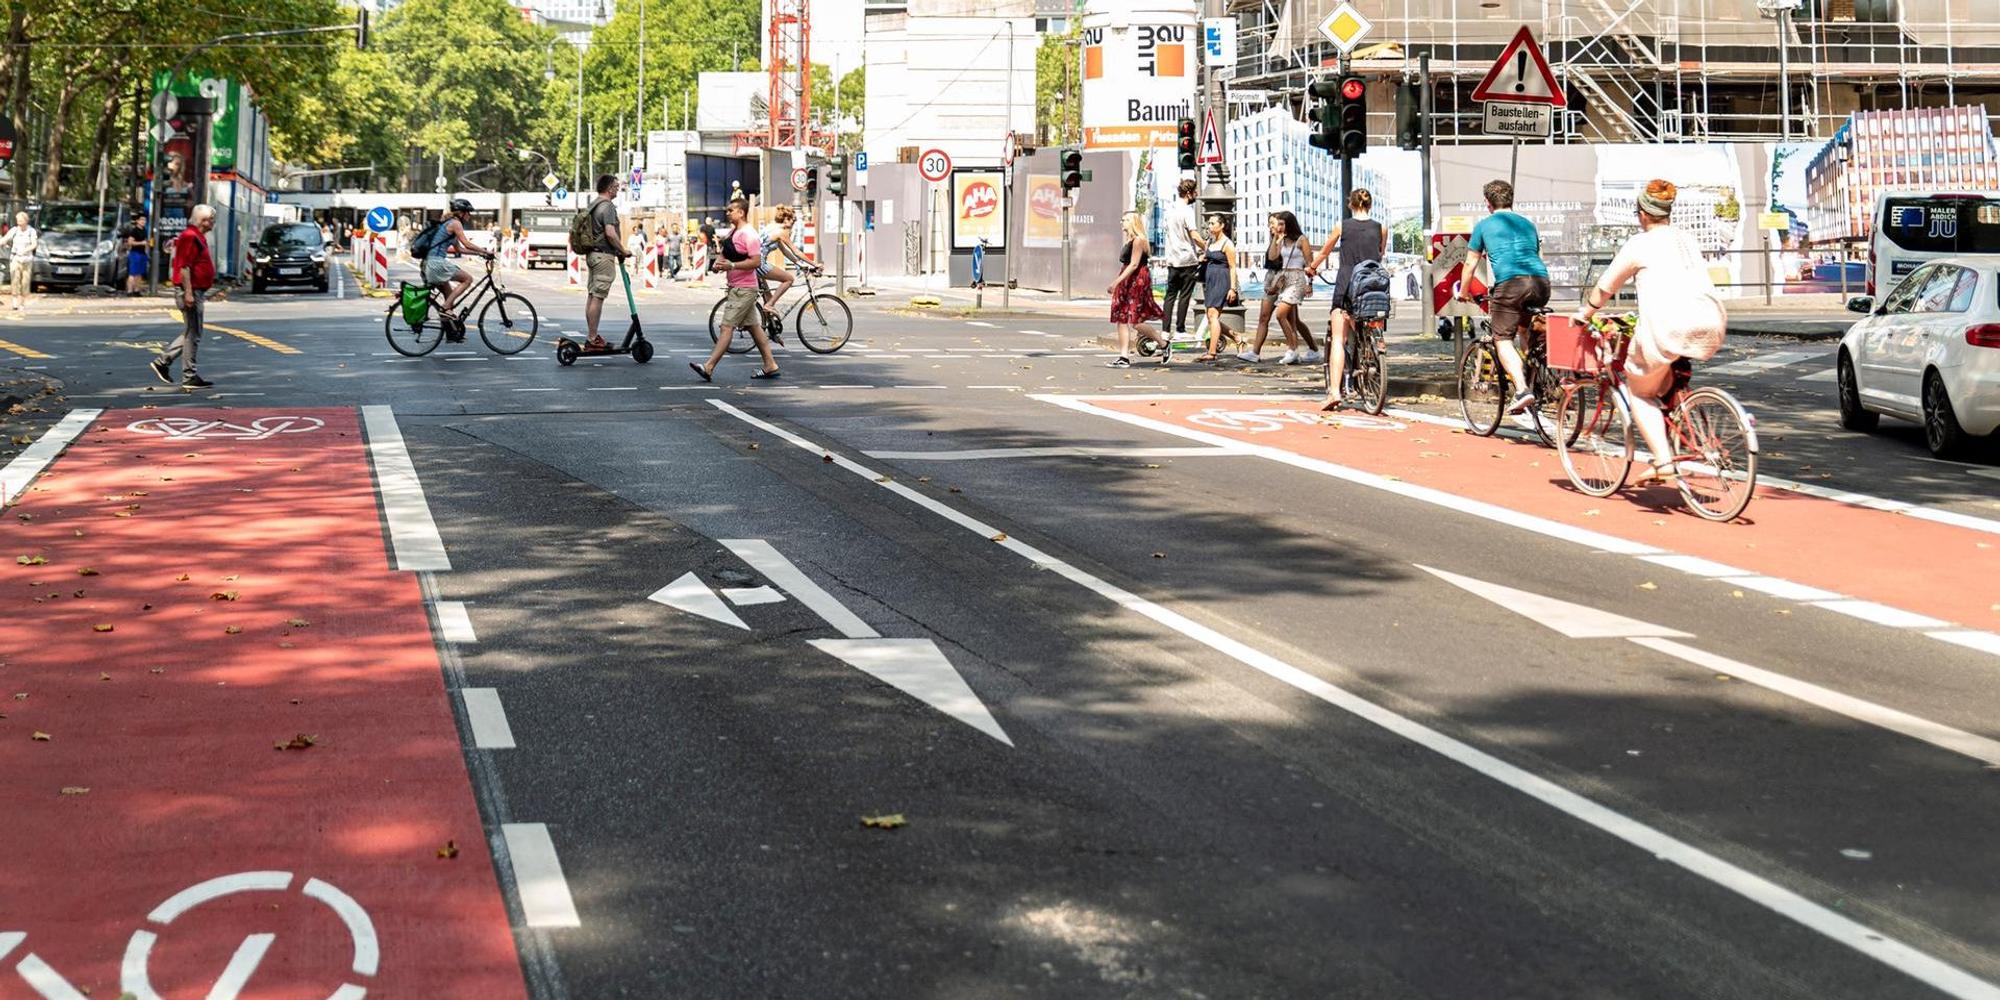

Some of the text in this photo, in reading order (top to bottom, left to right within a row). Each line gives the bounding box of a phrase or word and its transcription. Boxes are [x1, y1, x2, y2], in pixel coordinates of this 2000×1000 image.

[1128, 98, 1190, 122] Baumit
[1491, 105, 1544, 119] Baustellen-
[1498, 120, 1536, 132] ausfahrt
[925, 157, 945, 173] 30
[963, 186, 997, 210] AHA
[1928, 219, 1957, 238] JU
